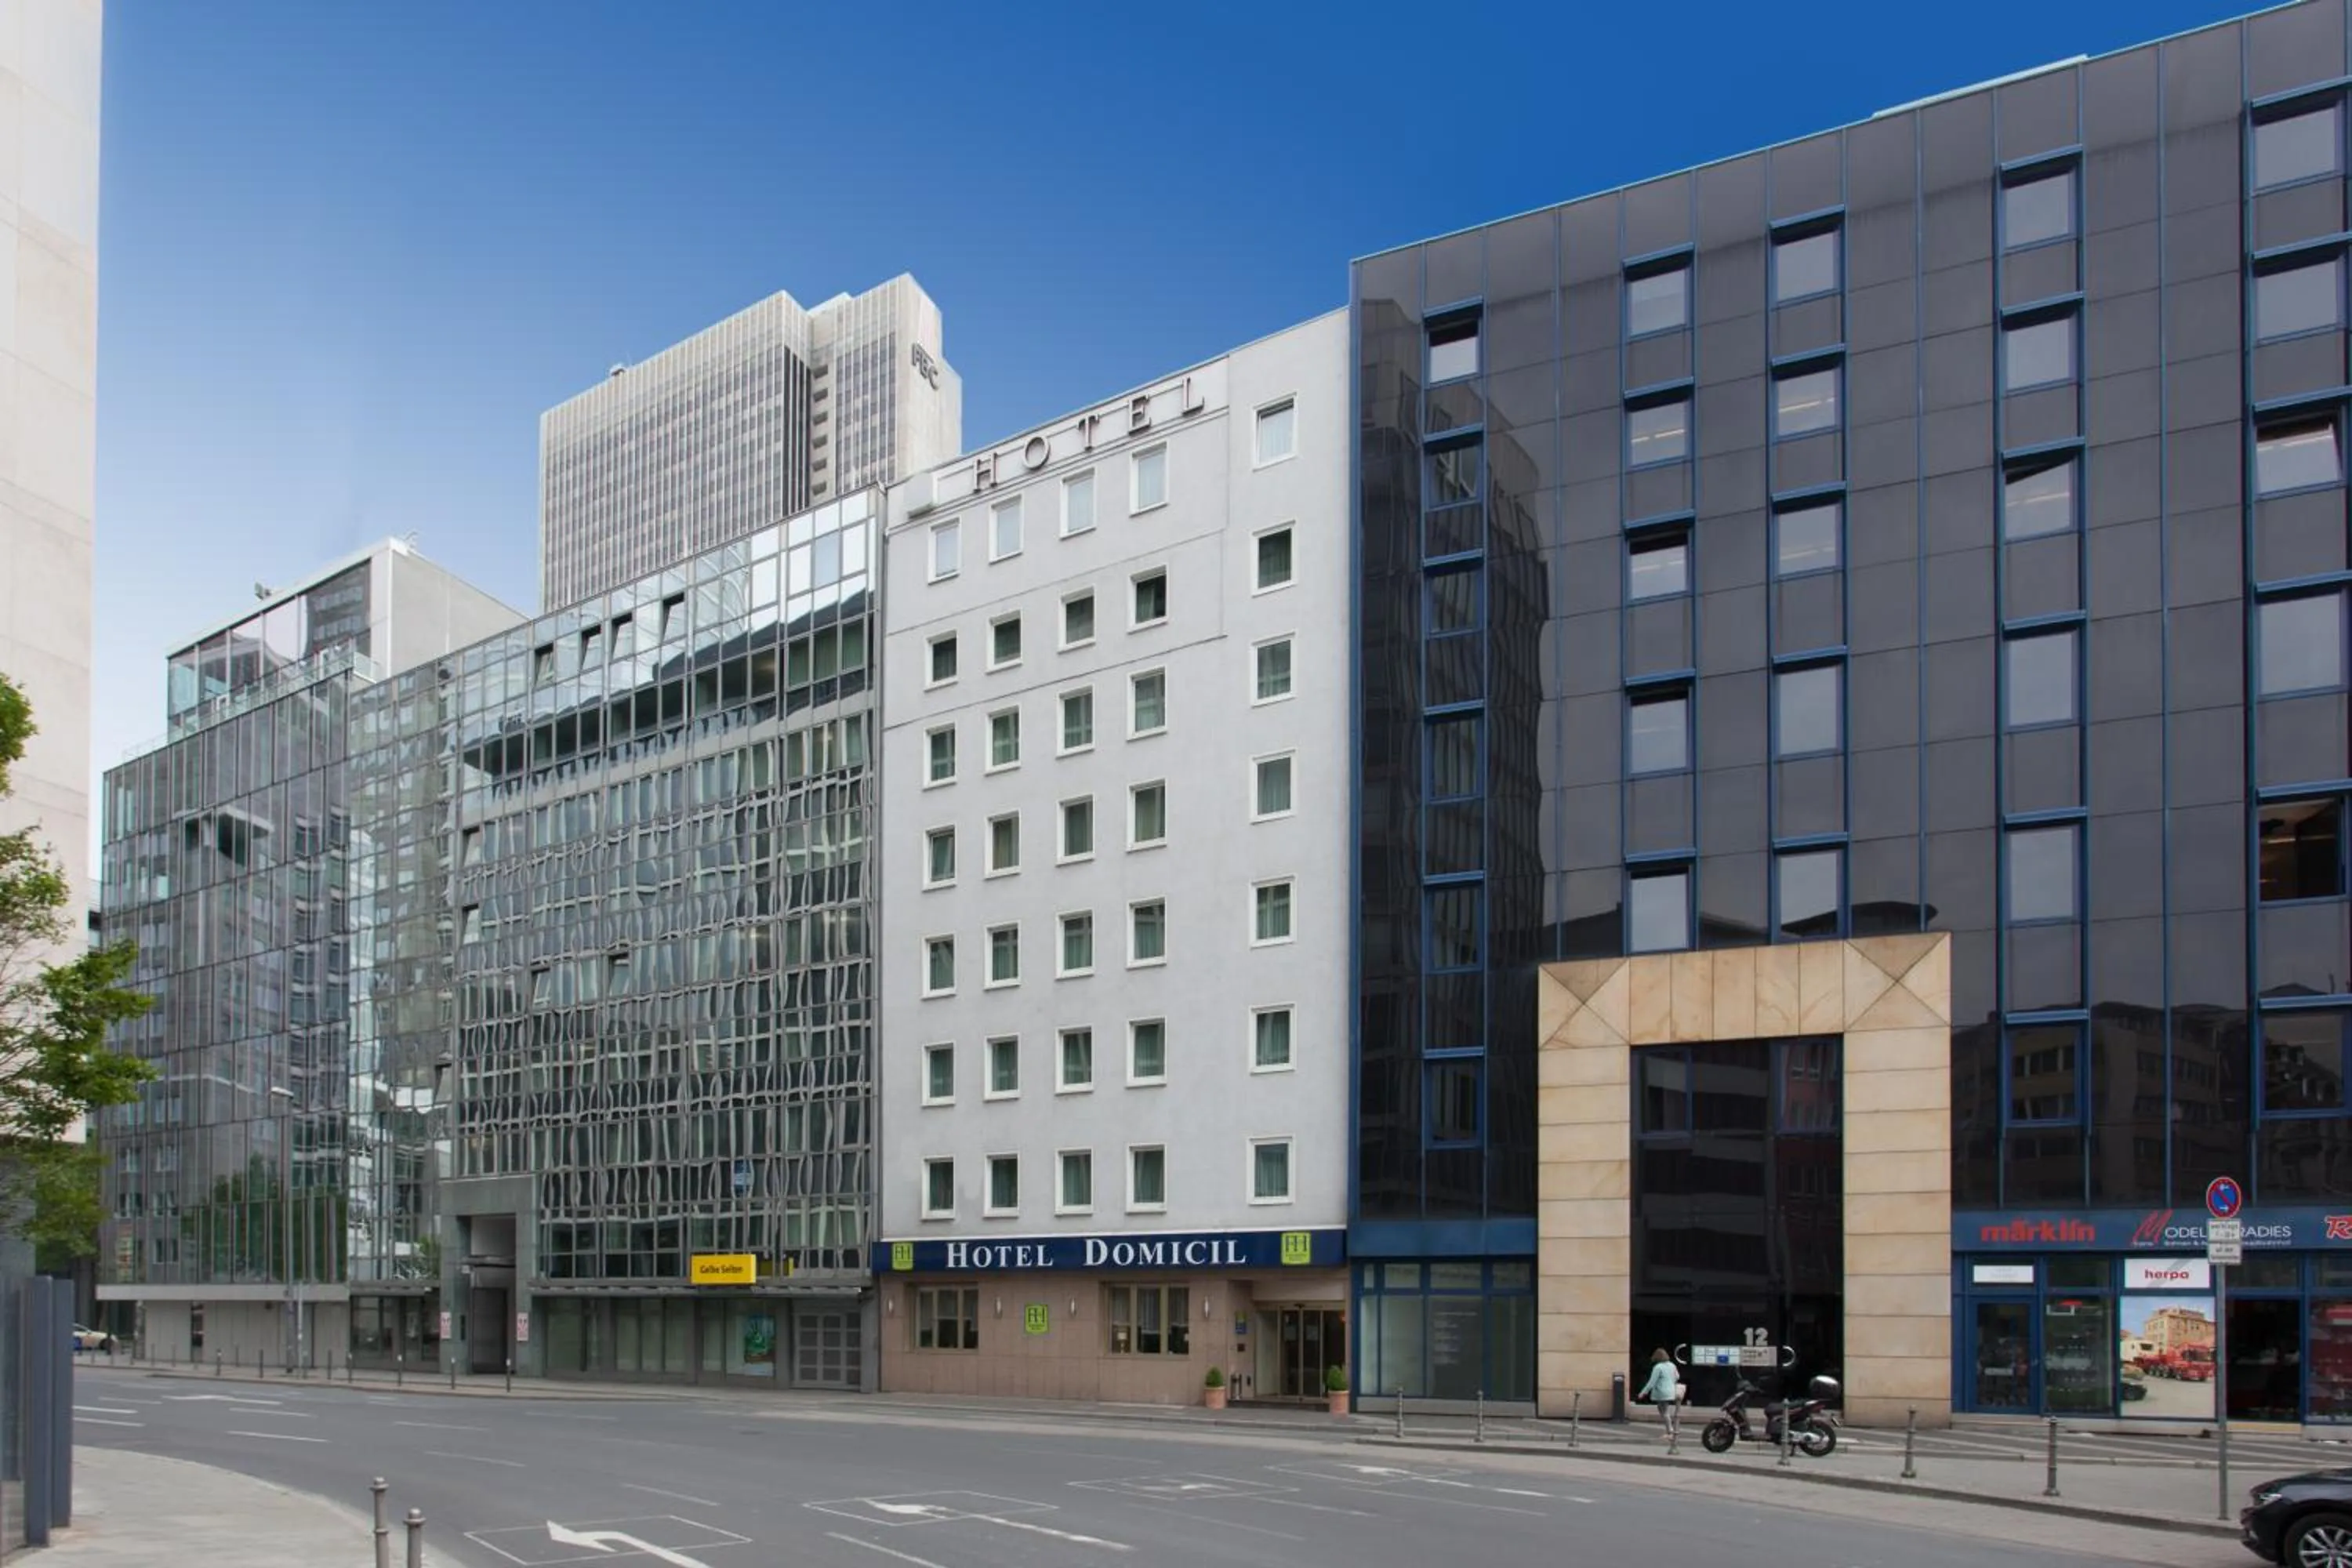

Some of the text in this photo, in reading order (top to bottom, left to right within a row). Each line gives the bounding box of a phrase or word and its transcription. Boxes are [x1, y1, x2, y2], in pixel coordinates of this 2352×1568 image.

[973, 376, 1205, 493] HOTEL
[1981, 1217, 2095, 1242] märklin
[947, 1238, 1247, 1268] HOTEL DOMICIL
[2144, 1269, 2190, 1280] herpa
[1744, 1327, 1769, 1346] 12
